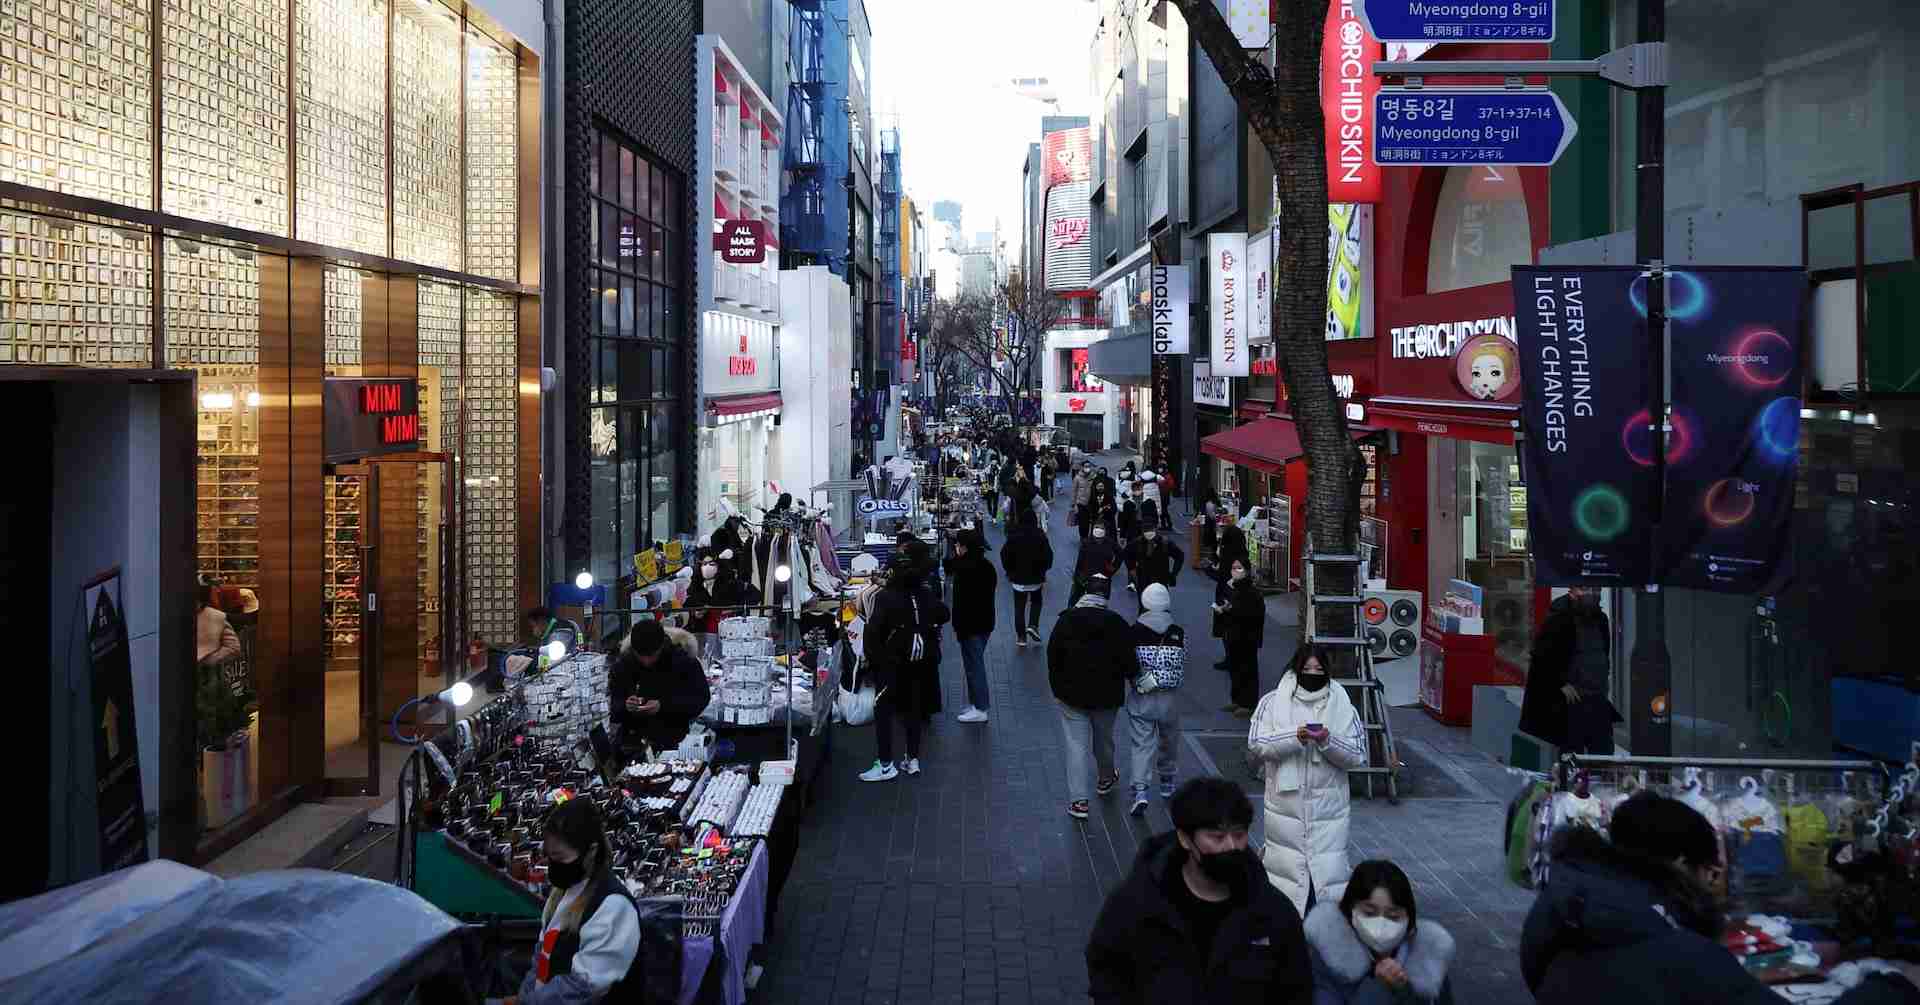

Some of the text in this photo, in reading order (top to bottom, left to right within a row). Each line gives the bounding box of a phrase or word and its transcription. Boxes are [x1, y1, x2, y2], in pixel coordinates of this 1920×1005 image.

[1409, 2, 1547, 19] Myeongdong 8-gil
[1381, 97, 1455, 121] 명동8길
[1380, 126, 1520, 142] Myeongdong 8-gil
[735, 226, 752, 235] ALL
[730, 237, 756, 246] MASK
[729, 248, 757, 257] STORY
[1154, 266, 1173, 353] masklab
[1223, 278, 1236, 363] ROYAL SKIN
[1562, 276, 1593, 417] EVERYTHING
[1534, 276, 1567, 453] LIGHT CHANGES
[1706, 353, 1769, 365] Myeongdong
[366, 384, 401, 413] MIMI
[384, 415, 417, 443] MIMI
[1738, 482, 1761, 494] Light
[860, 500, 908, 512] OREO
